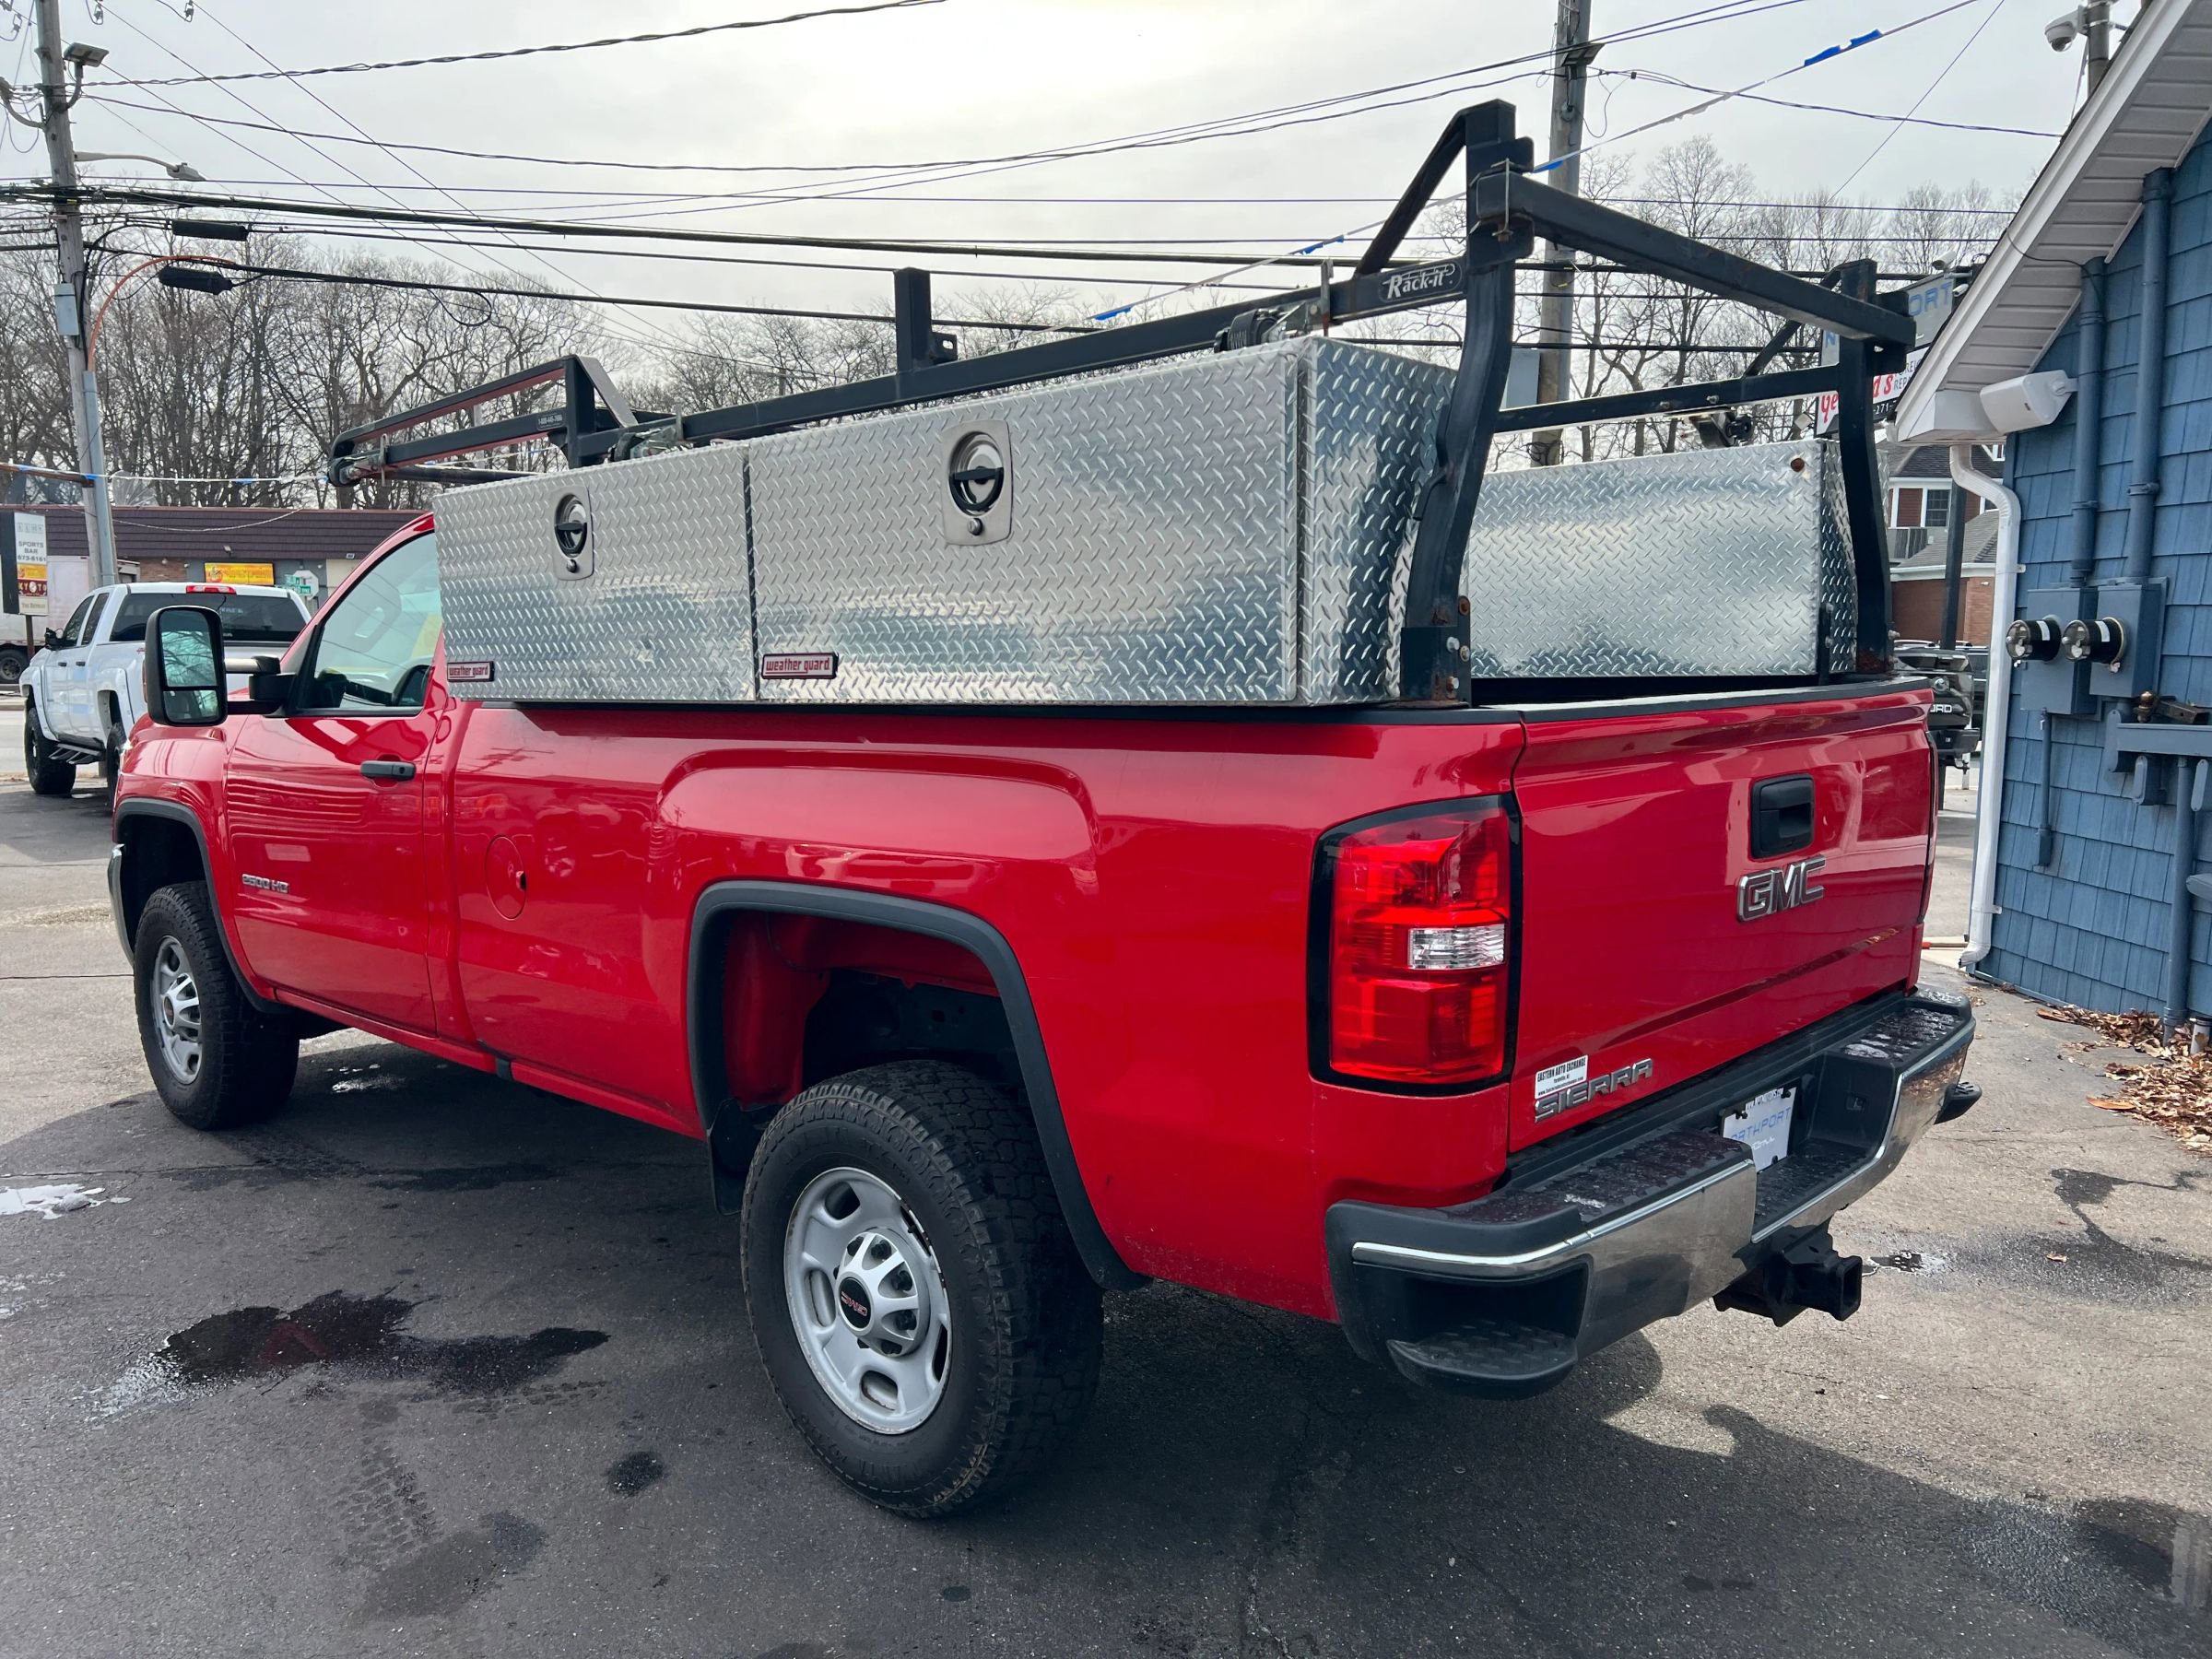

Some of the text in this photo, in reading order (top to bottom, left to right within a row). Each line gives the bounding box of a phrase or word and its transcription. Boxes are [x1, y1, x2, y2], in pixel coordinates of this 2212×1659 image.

[1385, 267, 1447, 300] Rack-it
[766, 657, 830, 674] weather guard
[1930, 703, 1953, 712] ORD
[241, 873, 271, 890] 2500
[1737, 854, 1827, 923] GMC
[1537, 1066, 1555, 1083] EASTERN
[1555, 1063, 1566, 1076] AUTO
[1566, 1056, 1586, 1073] EXCHANGE
[1535, 1058, 1653, 1124] SIERRA
